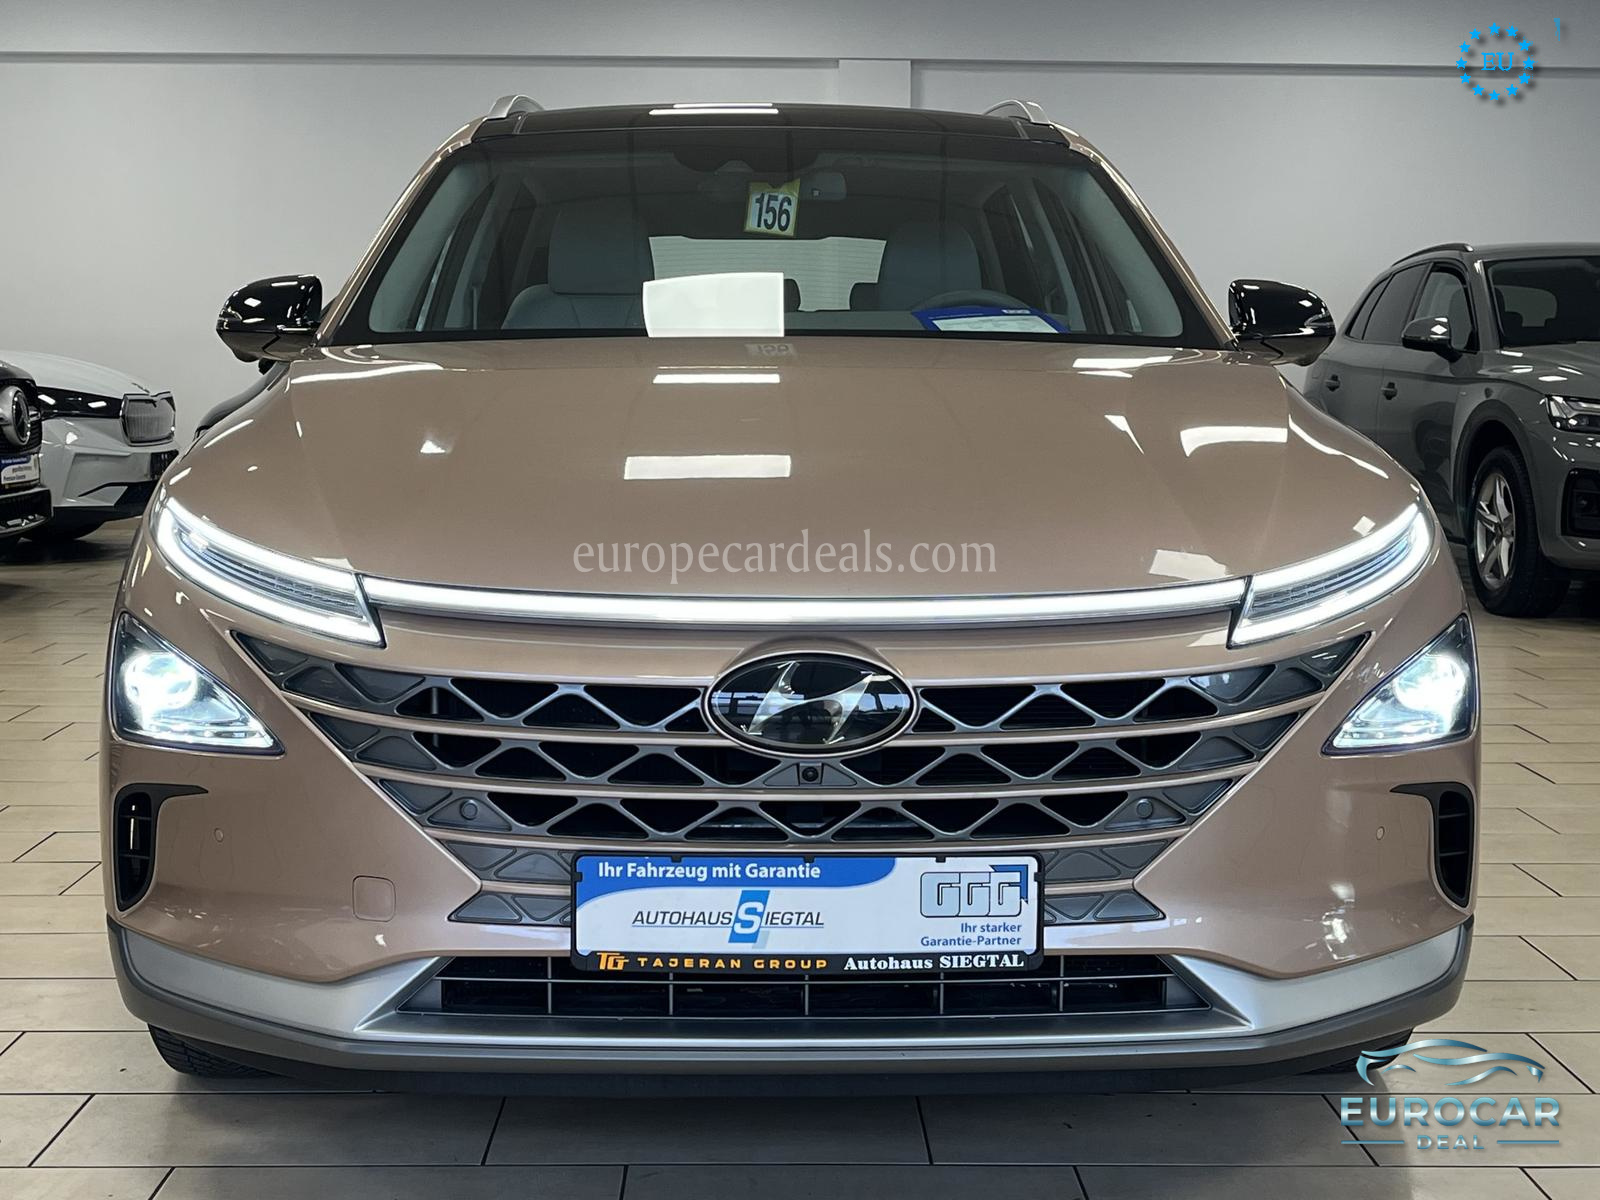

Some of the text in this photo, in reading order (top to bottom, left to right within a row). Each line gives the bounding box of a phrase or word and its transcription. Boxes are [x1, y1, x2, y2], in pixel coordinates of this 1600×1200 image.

[755, 192, 792, 232] 156
[599, 862, 820, 882] Ihr Fahrzeug mit Garantie
[920, 871, 1022, 918] GGG
[632, 911, 733, 925] AUTOHAUS
[961, 922, 1022, 933] Ihr starker
[921, 935, 1022, 947] Garantie-Partner
[637, 957, 741, 969] TAJERAN
[753, 959, 828, 969] GROUP
[844, 954, 1024, 971] Autohaus SIEGTAL
